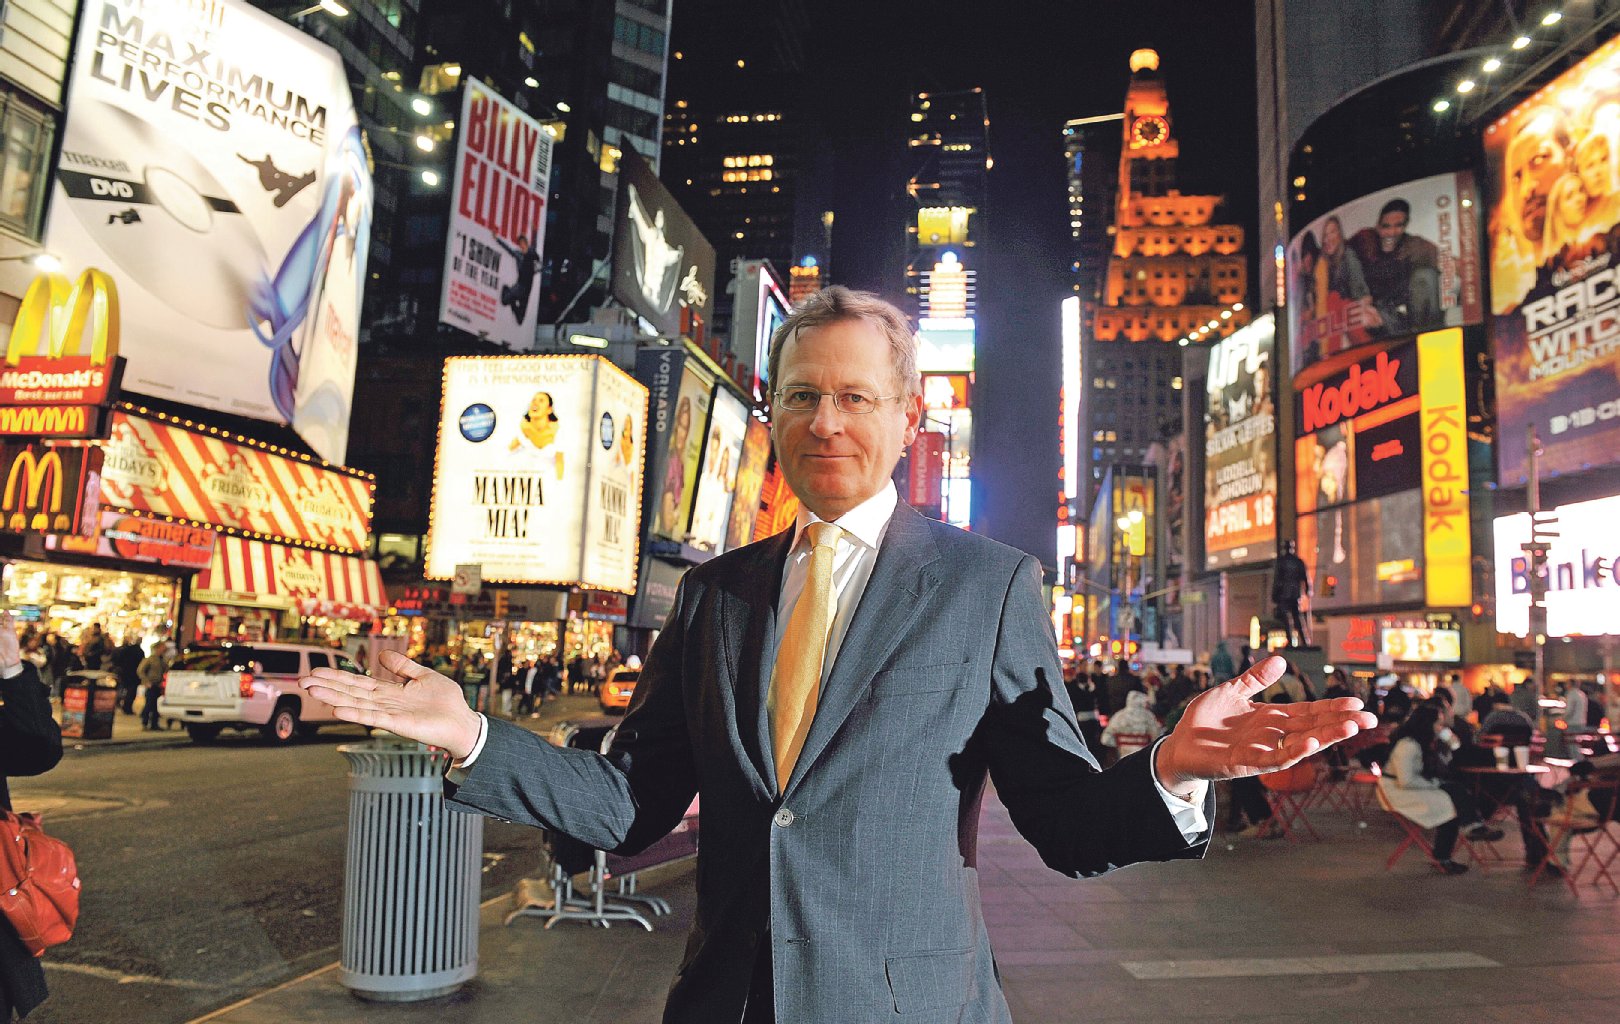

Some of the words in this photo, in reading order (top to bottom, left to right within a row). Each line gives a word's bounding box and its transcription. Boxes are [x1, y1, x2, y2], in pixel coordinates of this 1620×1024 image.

[91, 51, 232, 132] LIVES
[97, 30, 324, 147] PERFORMANCE
[100, 3, 327, 128] MAXIMUM
[466, 85, 538, 184] BILLY
[90, 178, 133, 198] DVD
[458, 152, 544, 248] ELLIOT
[1522, 263, 1620, 332] RAC
[1529, 309, 1620, 362] WITC
[1, 369, 104, 389] McDonald's
[656, 351, 672, 432] VORNADO
[1207, 315, 1275, 393] UFC
[1303, 351, 1402, 432] Kodak
[105, 454, 157, 477] RIDAY'S
[473, 476, 544, 506] MAMMA
[1426, 404, 1464, 533] Kodak
[486, 508, 528, 538] MIA!
[1208, 501, 1252, 538] APRIL
[1254, 494, 1274, 526] 18
